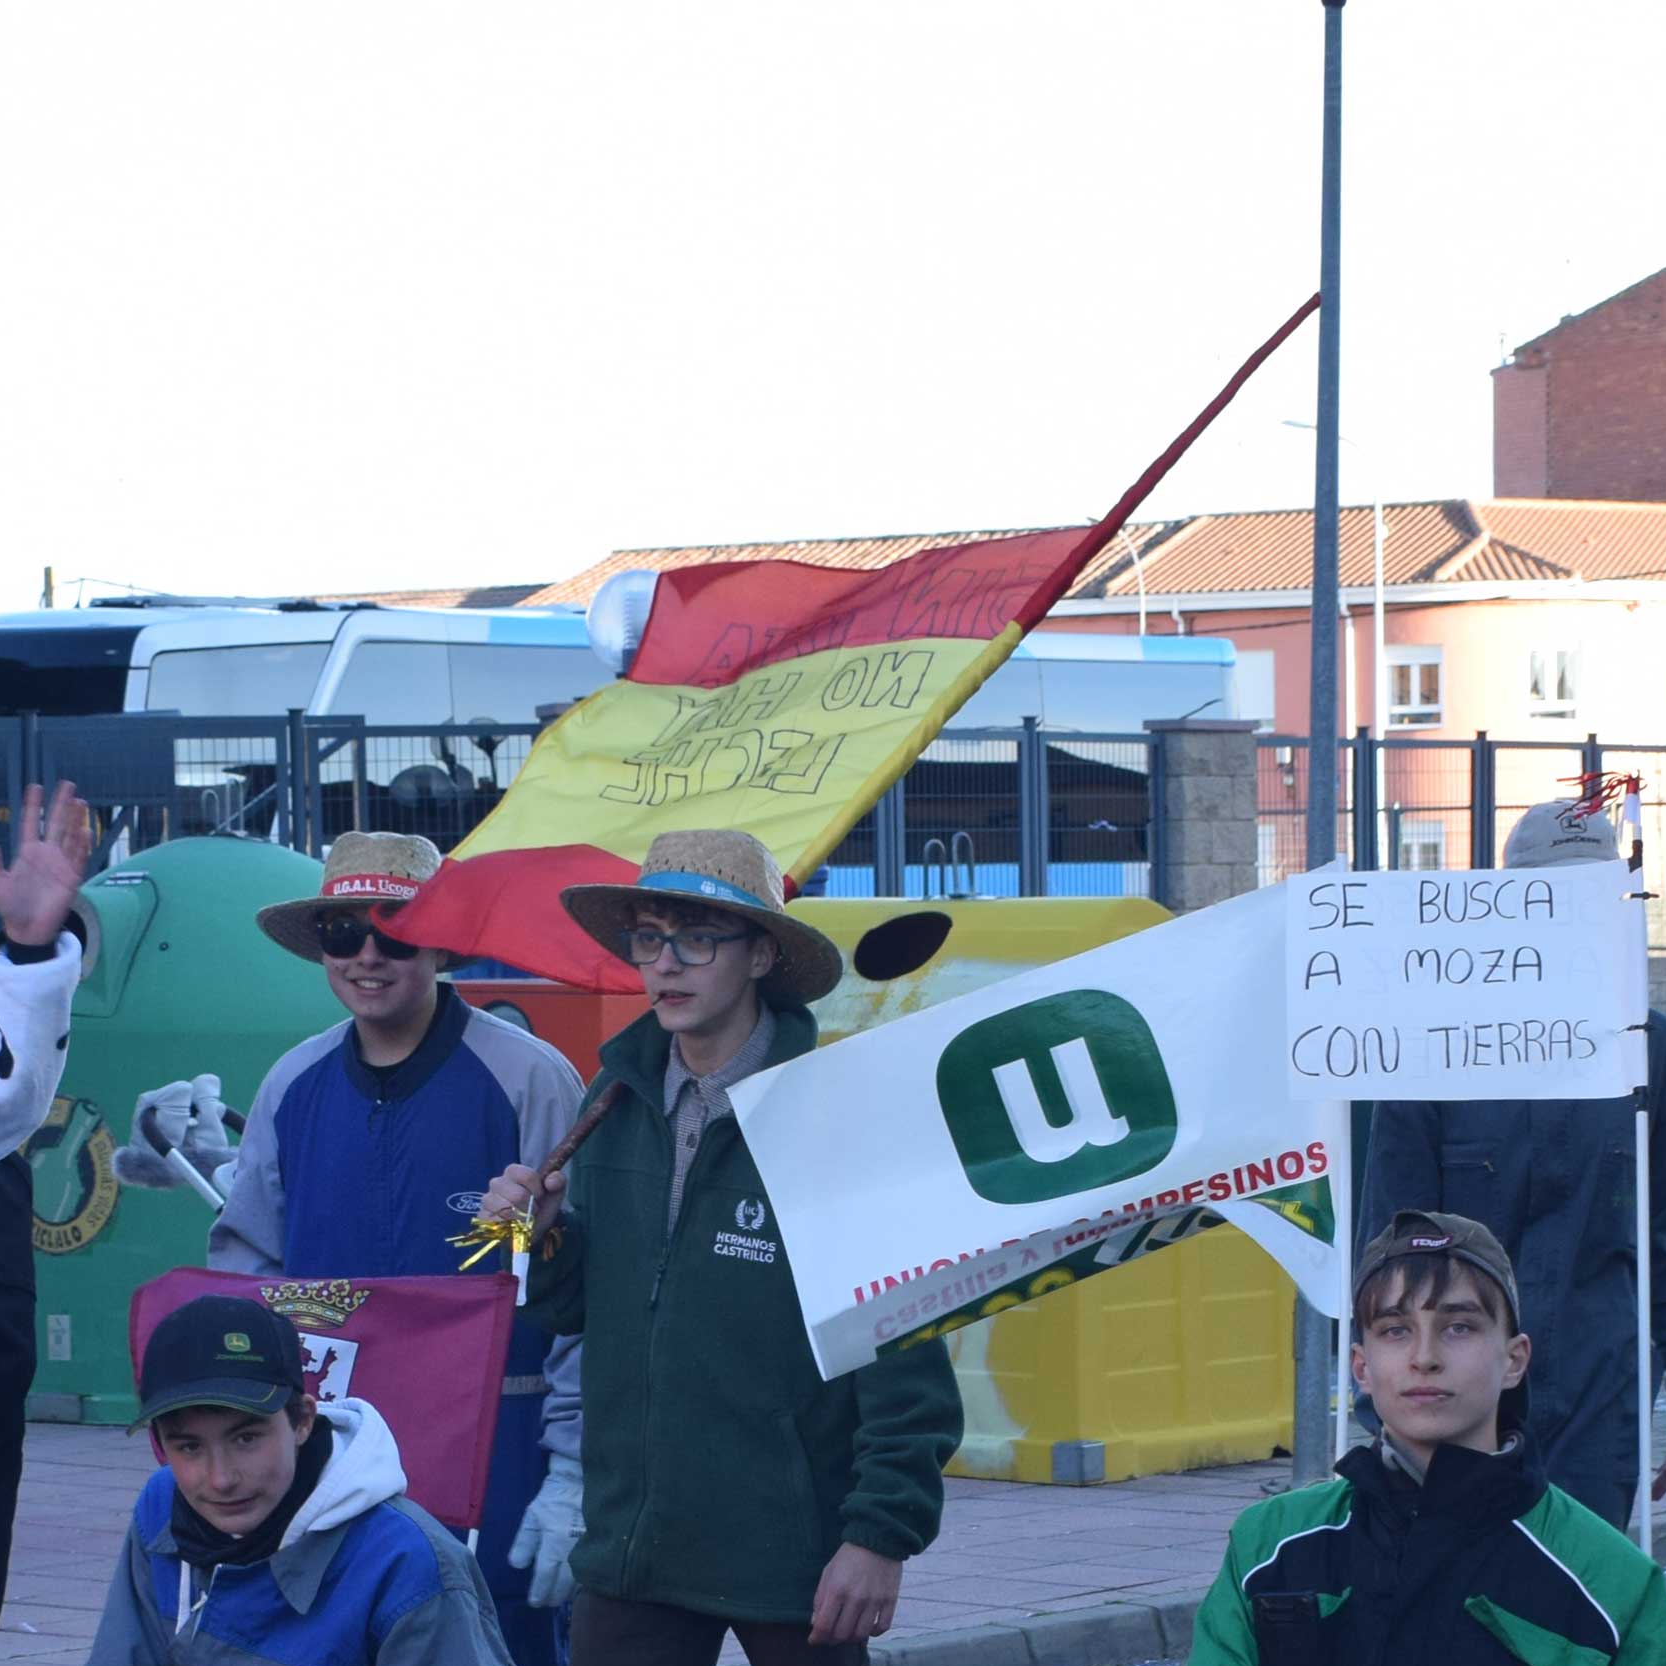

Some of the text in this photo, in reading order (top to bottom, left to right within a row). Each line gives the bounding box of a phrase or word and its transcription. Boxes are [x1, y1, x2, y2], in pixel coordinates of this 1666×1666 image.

[333, 878, 377, 896] U.G.A.L.
[1308, 877, 1555, 930] SE BUSCA
[1304, 946, 1544, 991] A MOZA
[1291, 1018, 1598, 1079] CON TIERRAS
[713, 1243, 775, 1263] CASTRILLO
[716, 1231, 777, 1252] HERMANOS
